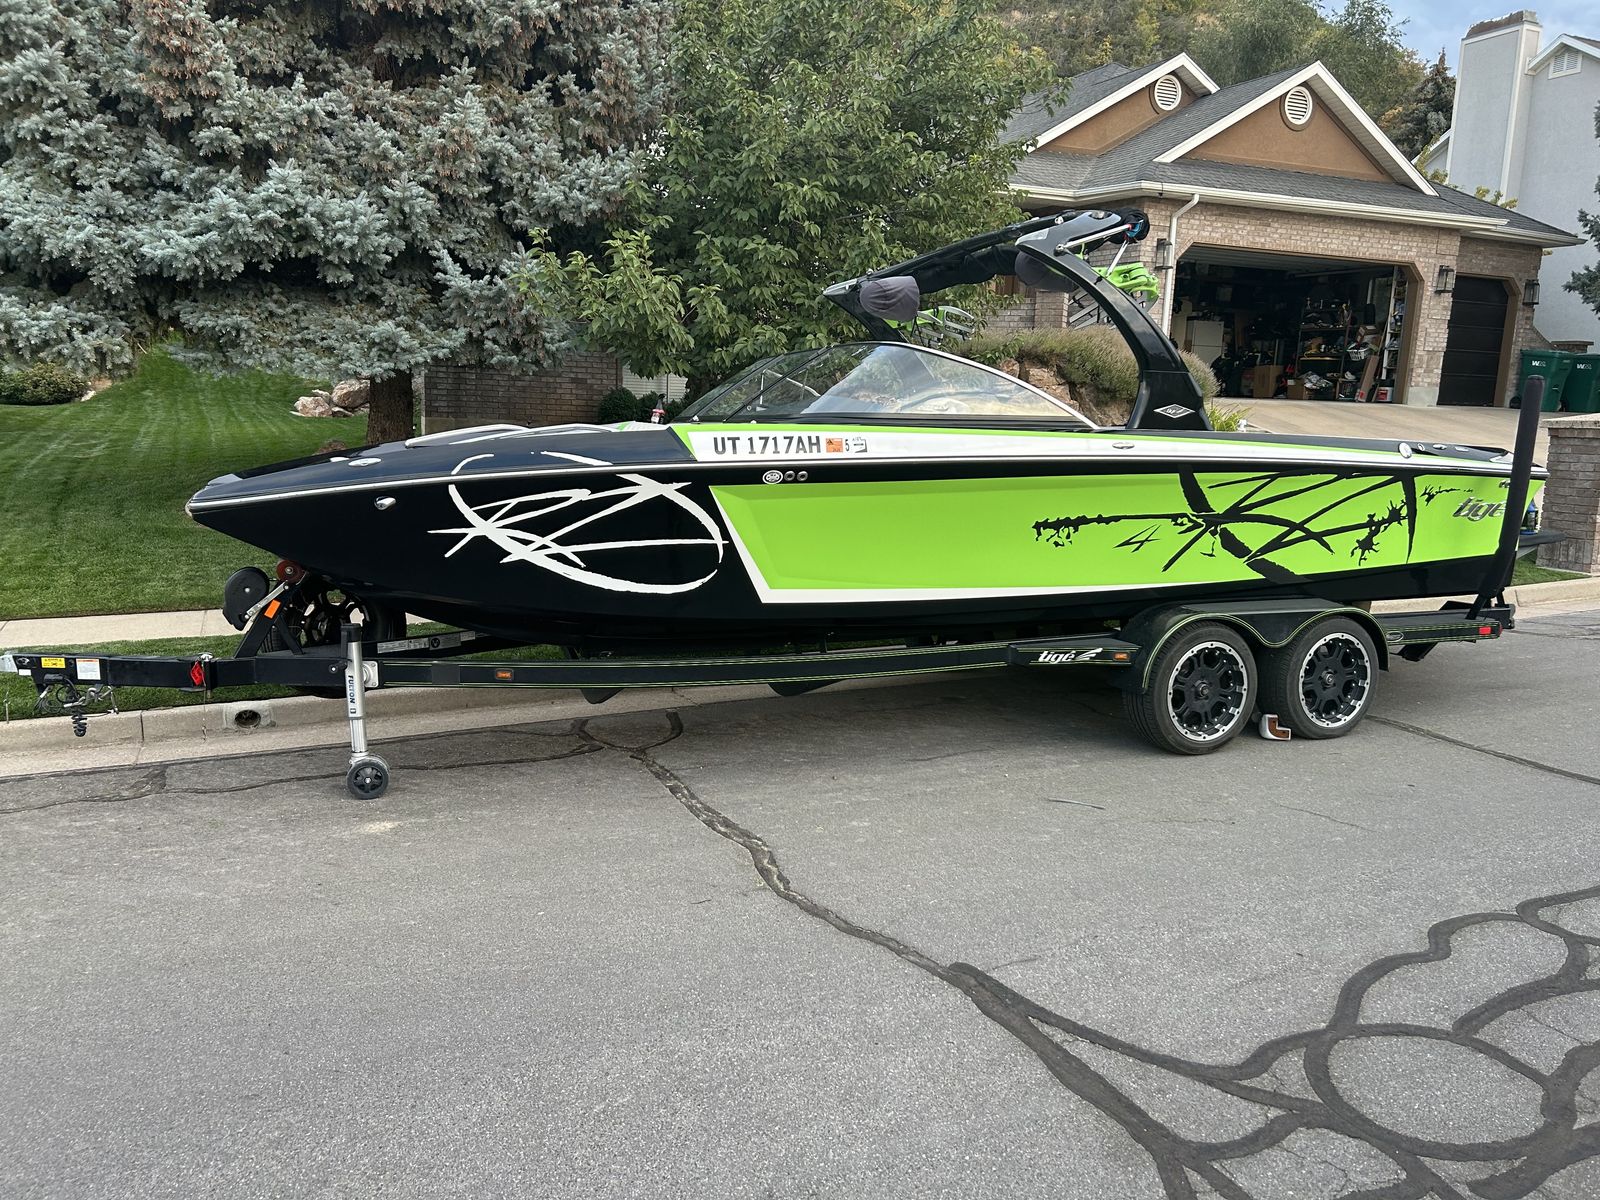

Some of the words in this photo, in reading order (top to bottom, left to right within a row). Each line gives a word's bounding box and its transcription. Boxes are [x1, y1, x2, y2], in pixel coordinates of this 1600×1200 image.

[713, 436, 740, 455] UT
[747, 435, 821, 454] 1717AH
[348, 675, 356, 704] FULTON
